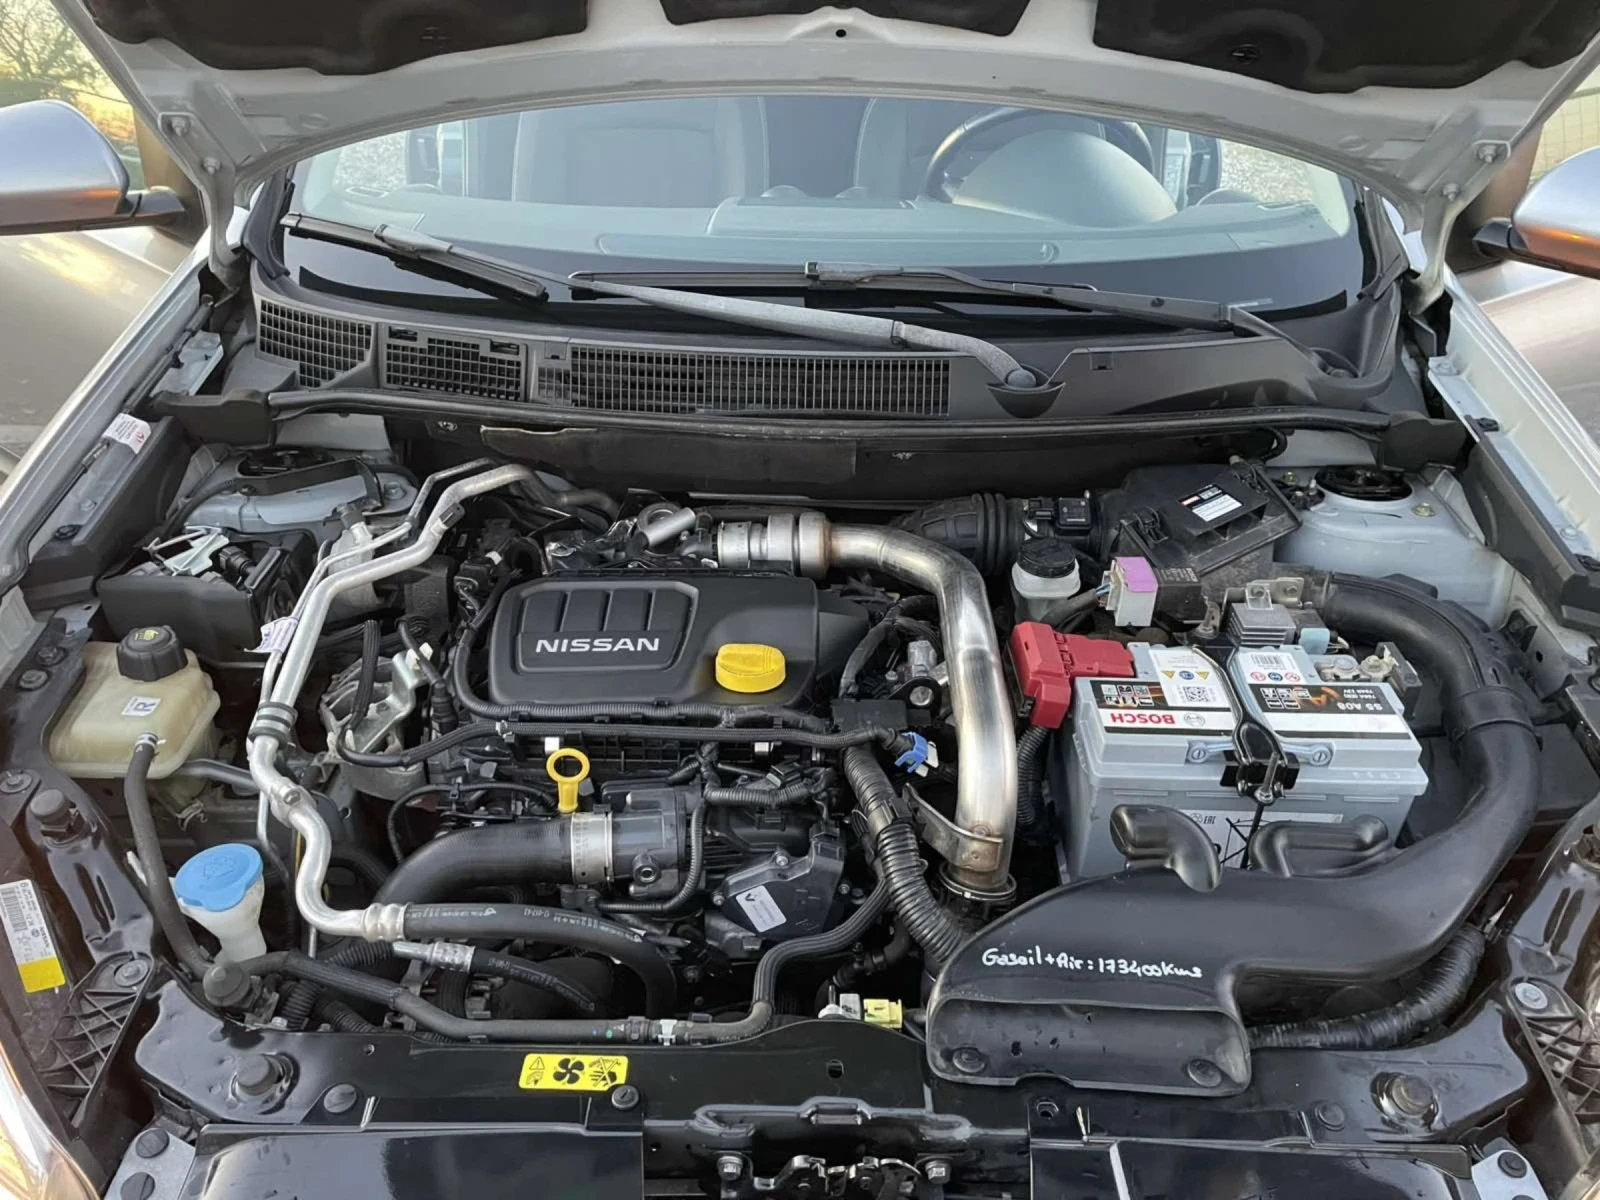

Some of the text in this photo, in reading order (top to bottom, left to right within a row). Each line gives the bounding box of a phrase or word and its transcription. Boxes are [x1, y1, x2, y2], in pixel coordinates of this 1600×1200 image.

[535, 637, 660, 653] NISSAN
[1337, 702, 1383, 711] S5 A08
[1110, 713, 1176, 725] BOSCH
